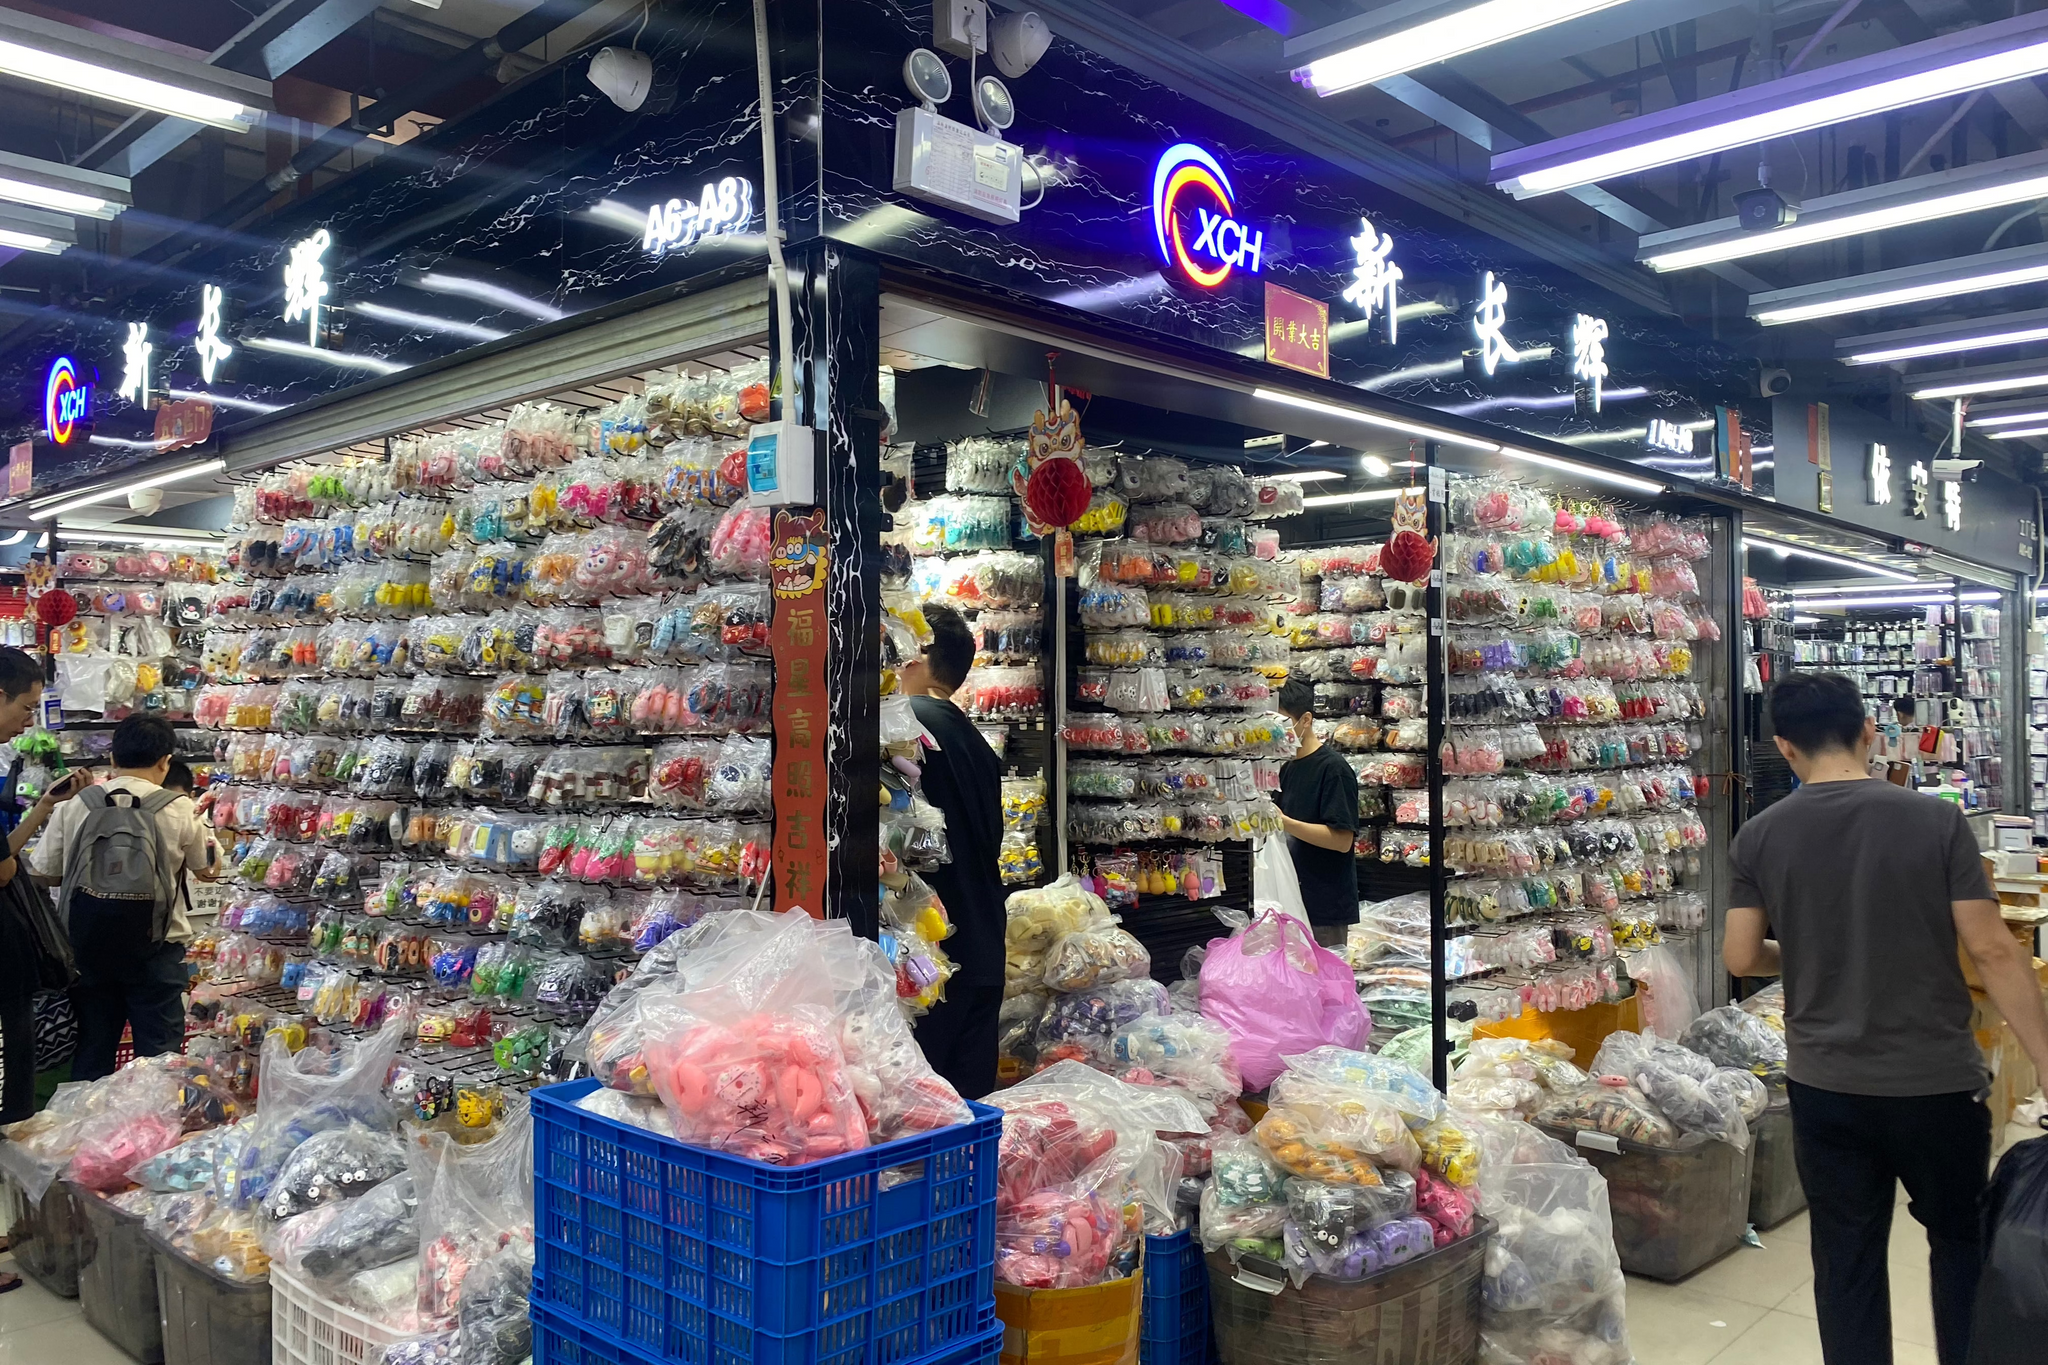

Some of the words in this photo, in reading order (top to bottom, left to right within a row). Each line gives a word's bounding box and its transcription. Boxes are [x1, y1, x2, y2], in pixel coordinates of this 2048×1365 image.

[642, 177, 743, 250] A6-A8
[1192, 207, 1263, 273] XCH
[1273, 316, 1321, 351] 開業大吉
[59, 386, 87, 423] XCH
[784, 607, 815, 902] 福星高照吉祥
[109, 892, 151, 901] WARRIOR
